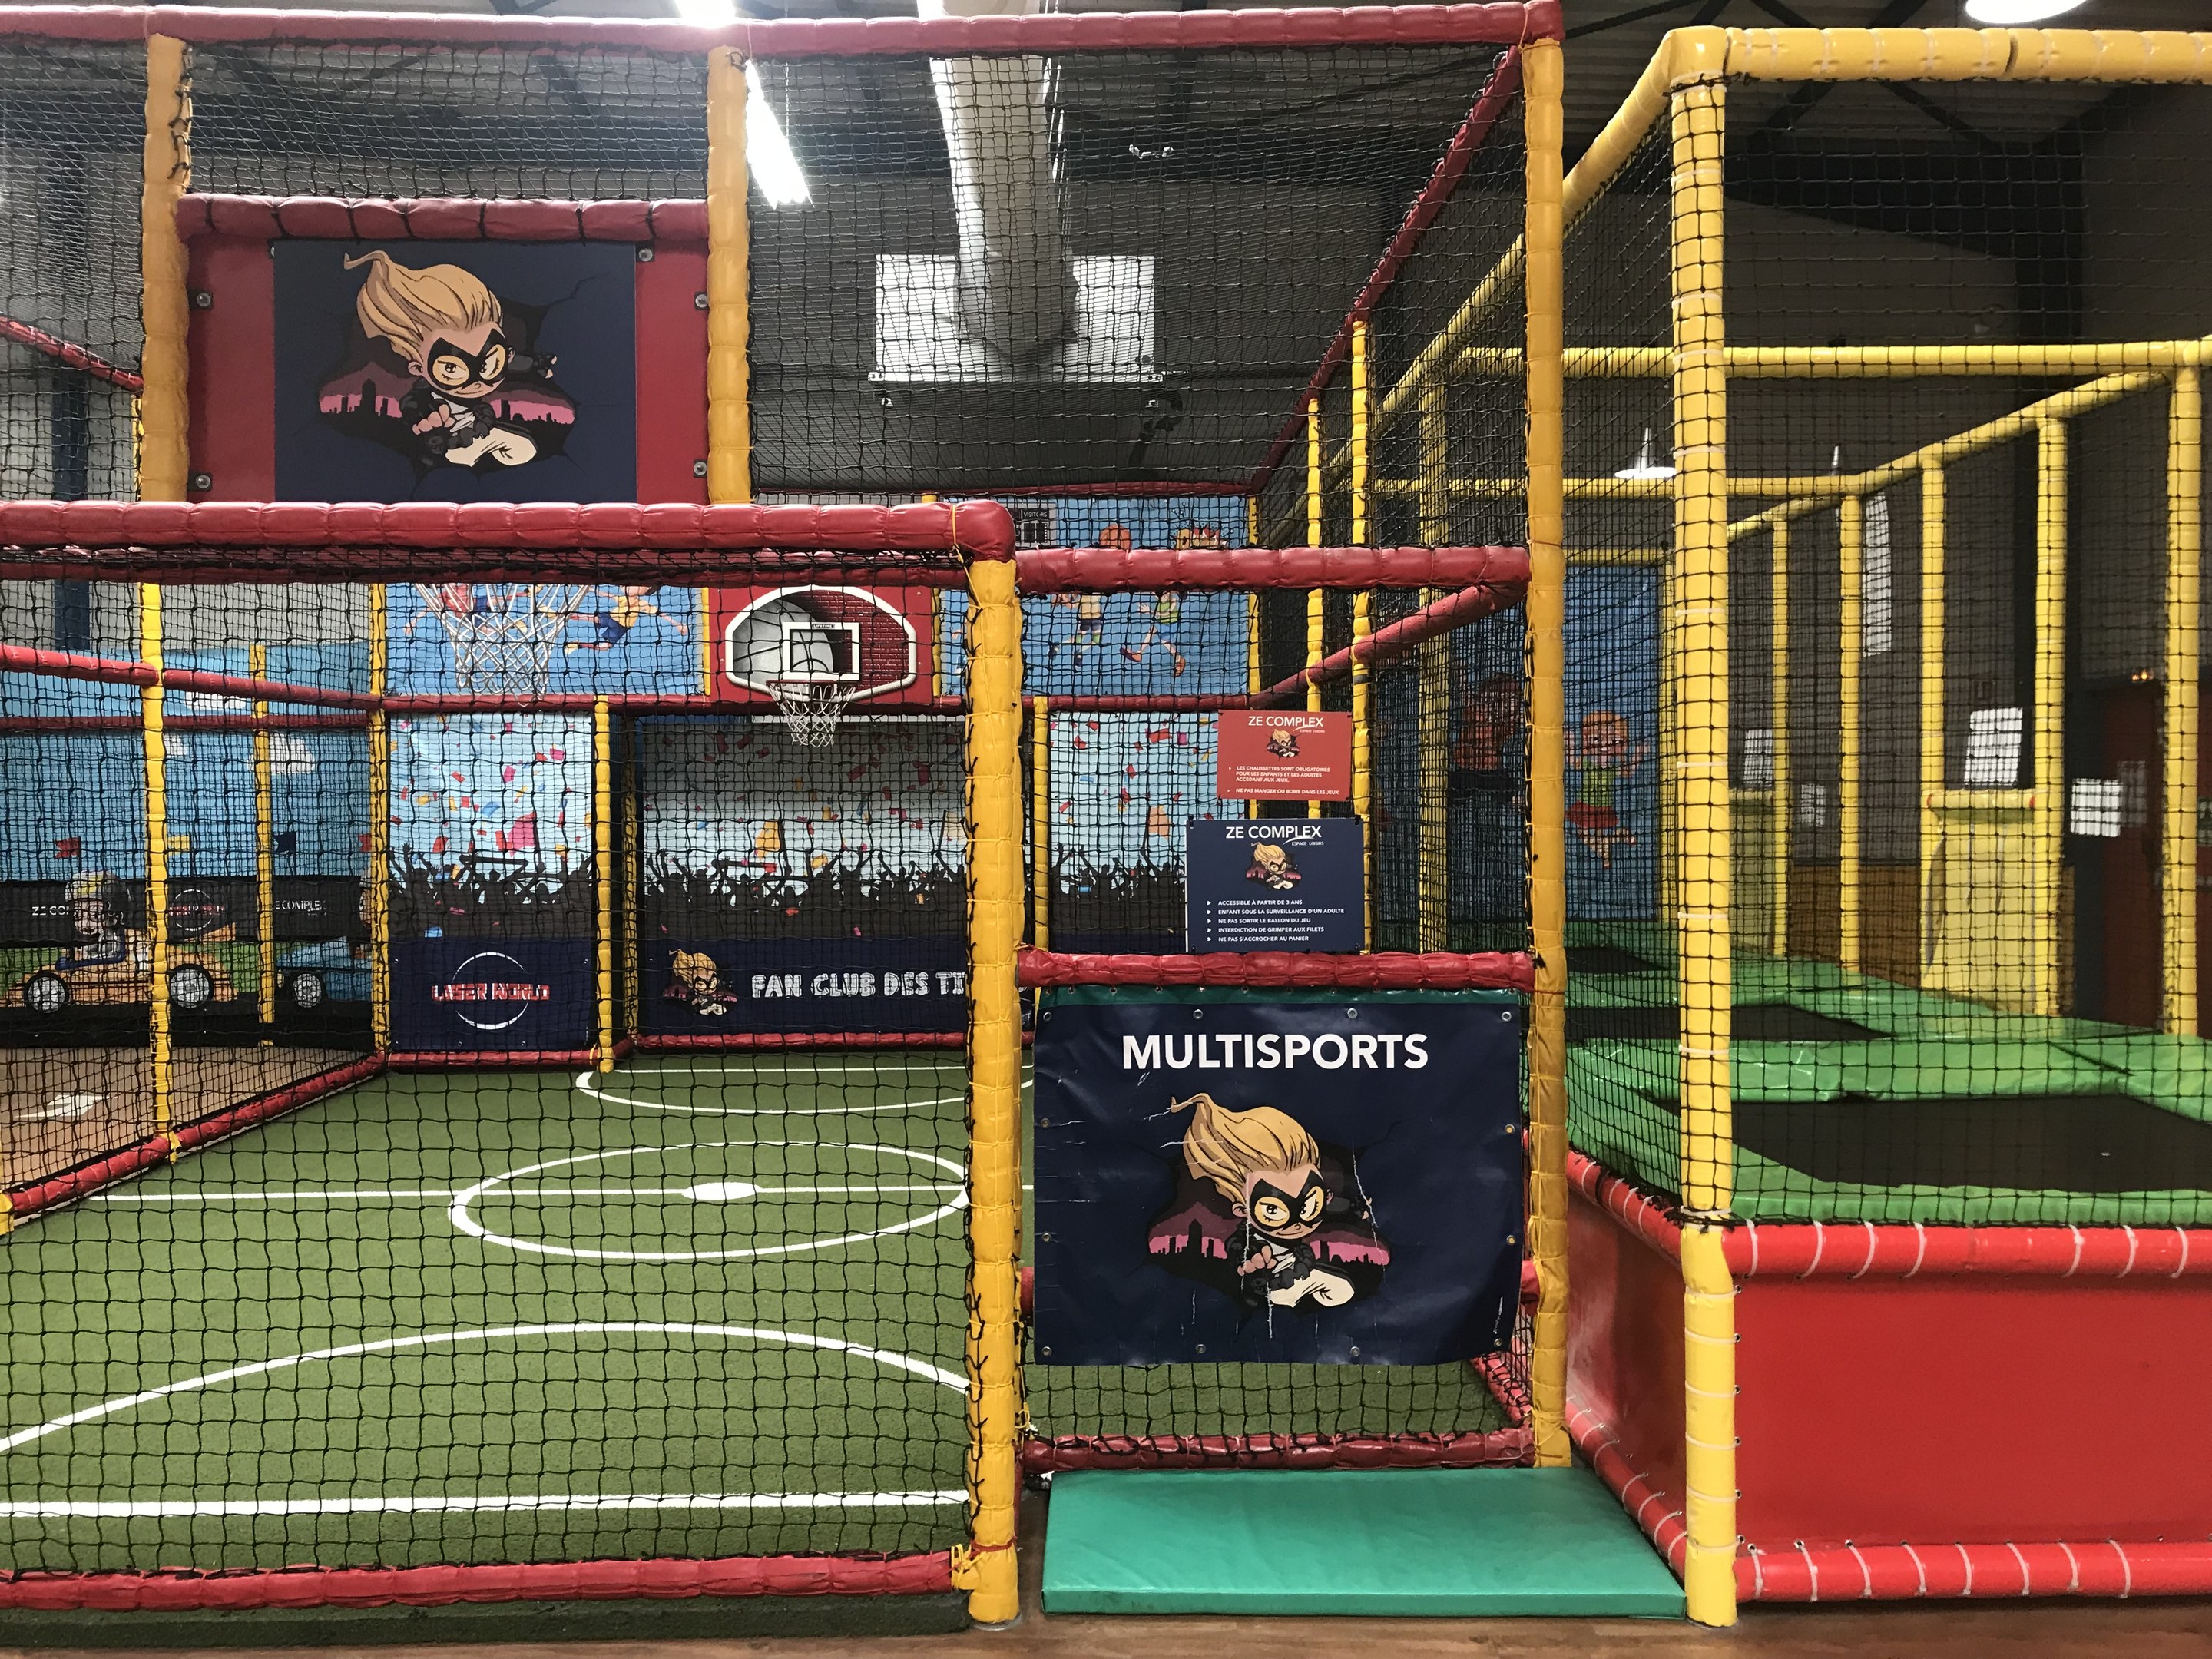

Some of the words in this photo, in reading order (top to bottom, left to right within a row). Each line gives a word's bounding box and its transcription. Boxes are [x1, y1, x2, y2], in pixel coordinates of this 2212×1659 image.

[1248, 716, 1263, 726] ZE
[1266, 716, 1323, 727] COMPLEX
[1226, 826, 1244, 839] ZE
[1248, 826, 1322, 839] COMPLEX
[432, 983, 487, 1001] LASER
[492, 983, 550, 1001] WORLD
[752, 974, 802, 998] FAN
[811, 972, 876, 997] CLUB
[884, 972, 929, 997] DES
[1123, 1033, 1429, 1070] MULTISPORTS
